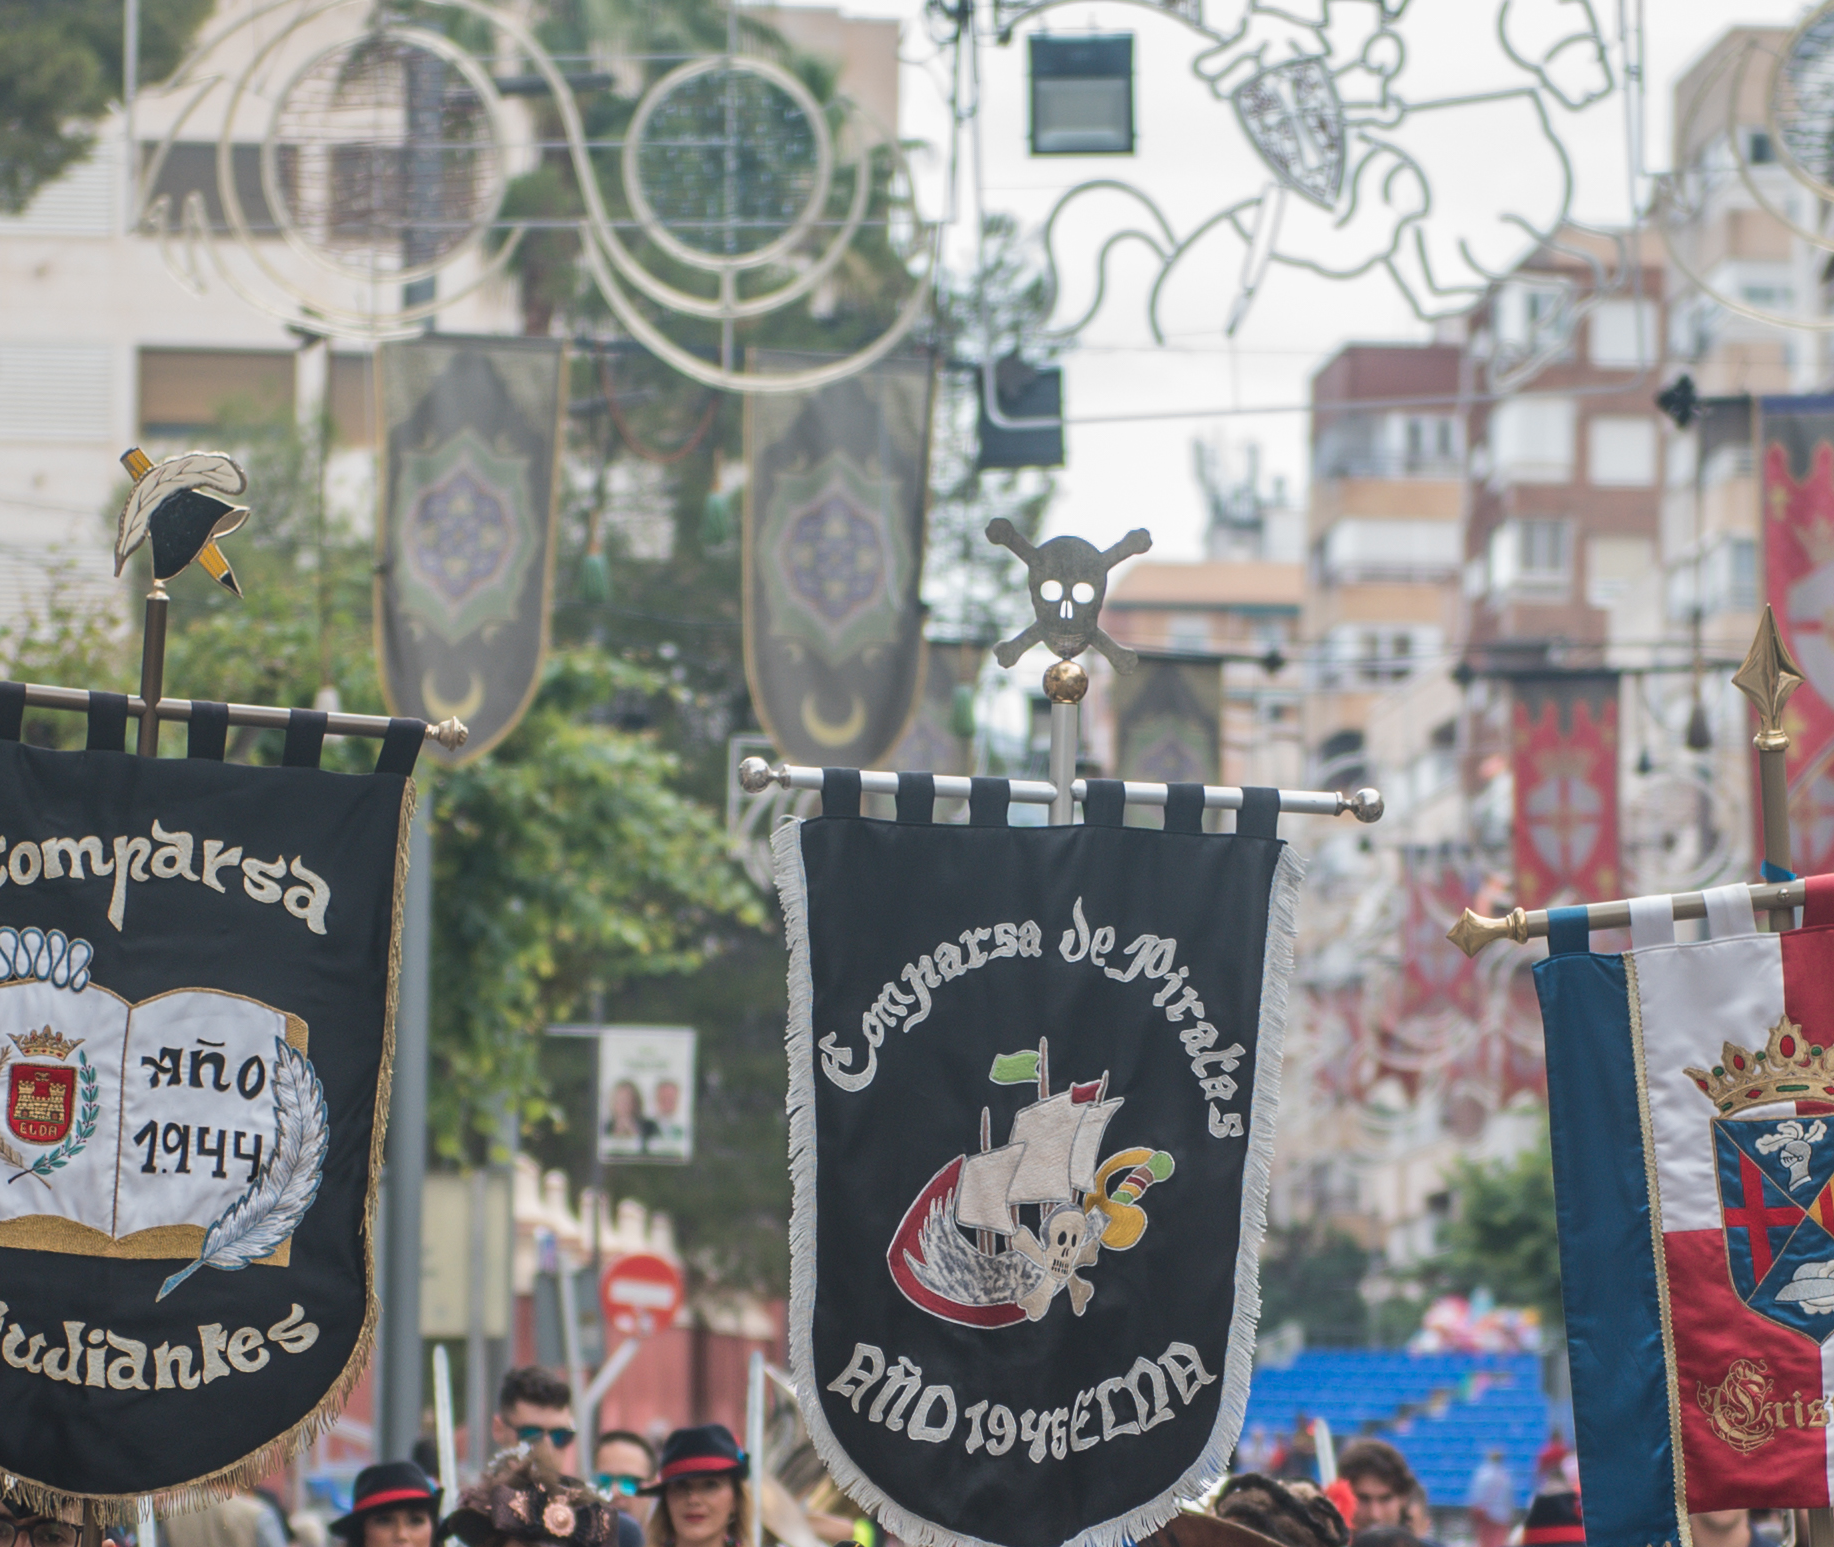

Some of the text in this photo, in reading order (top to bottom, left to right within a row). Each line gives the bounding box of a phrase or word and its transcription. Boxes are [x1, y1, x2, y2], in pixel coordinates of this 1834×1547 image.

[819, 895, 1246, 1139] Comparsa de Piratas
[19, 1121, 59, 1137] ELDA
[826, 1341, 1218, 1464] AÑO 1945 ELDA
